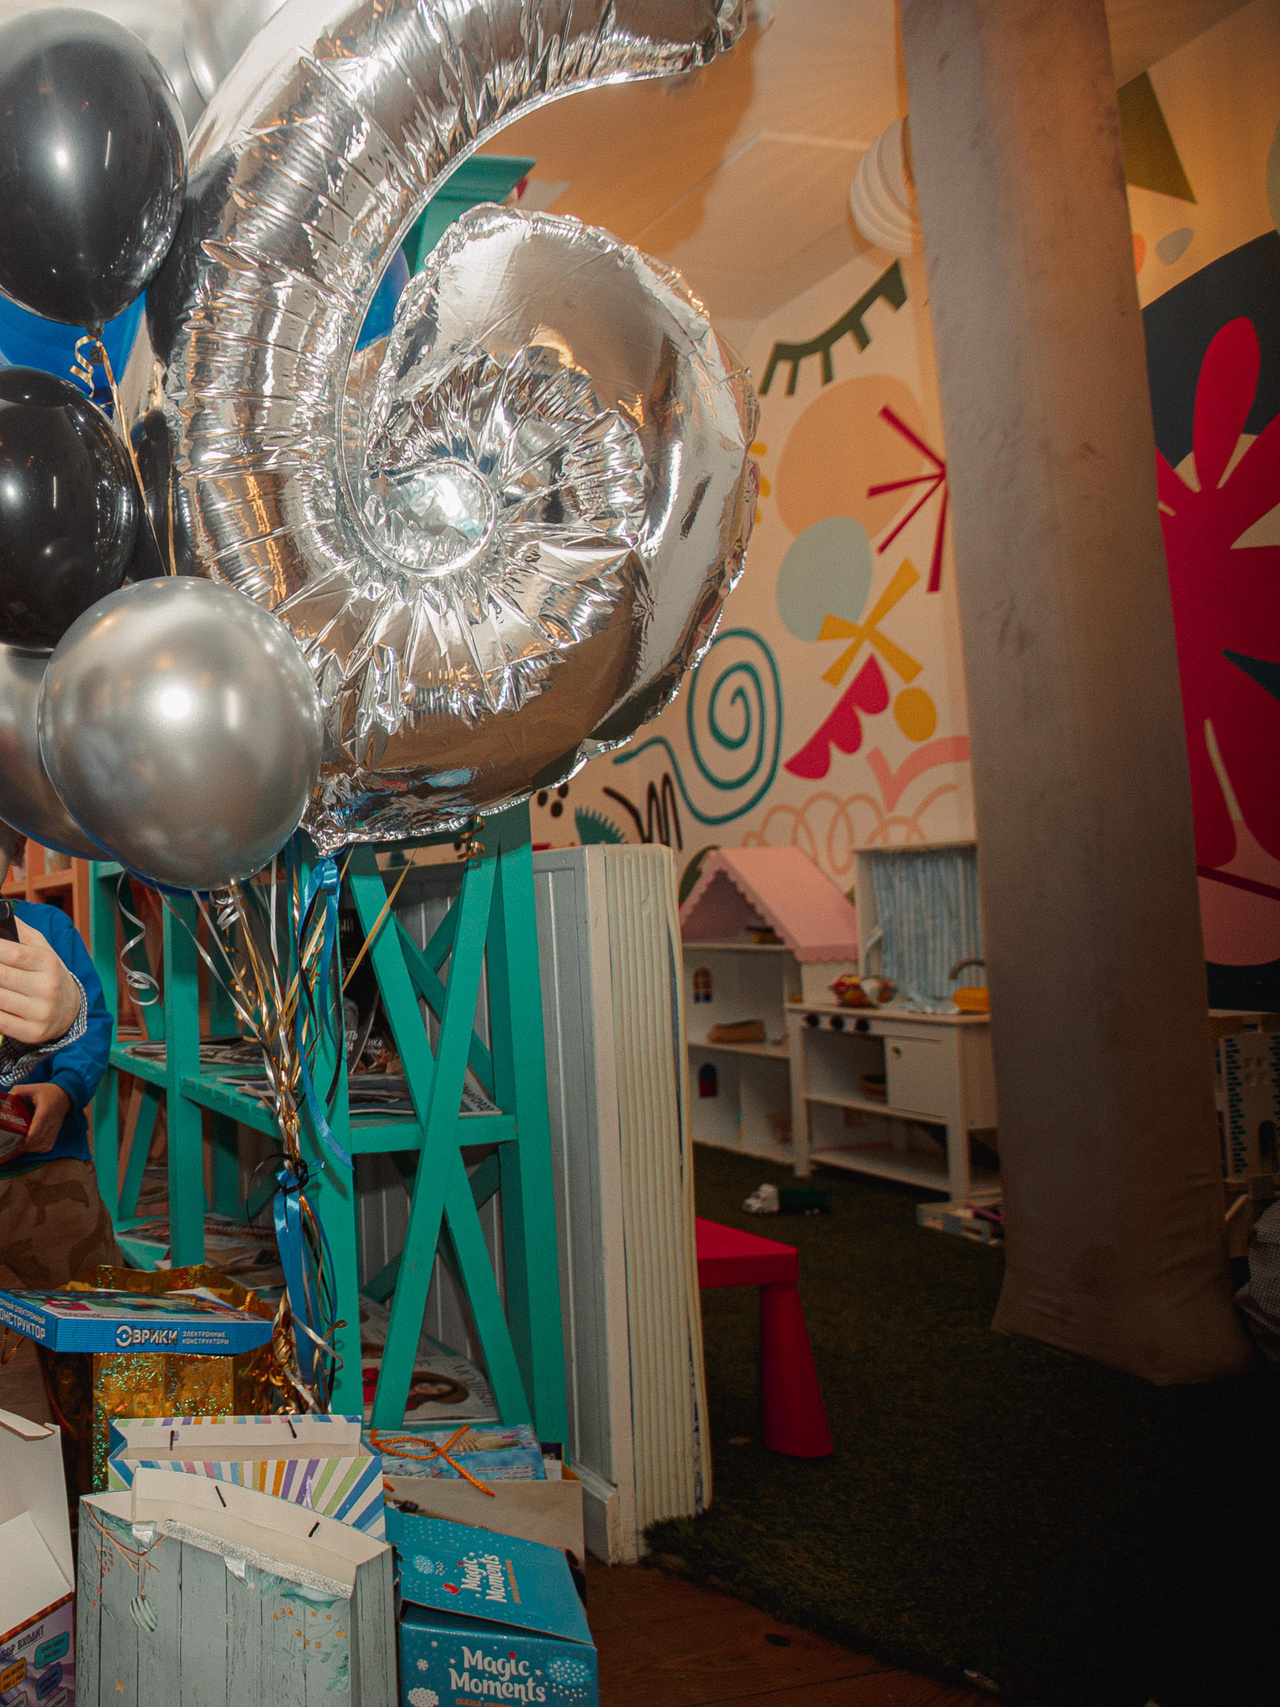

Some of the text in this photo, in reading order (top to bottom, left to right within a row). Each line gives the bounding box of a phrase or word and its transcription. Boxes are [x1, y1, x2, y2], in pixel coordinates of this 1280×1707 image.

[116, 1325, 178, 1347] ЭВРИКИ
[459, 1556, 487, 1592] Magic
[477, 1553, 508, 1603] Moments
[461, 1646, 530, 1681] Magic
[448, 1668, 546, 1702] Moments
